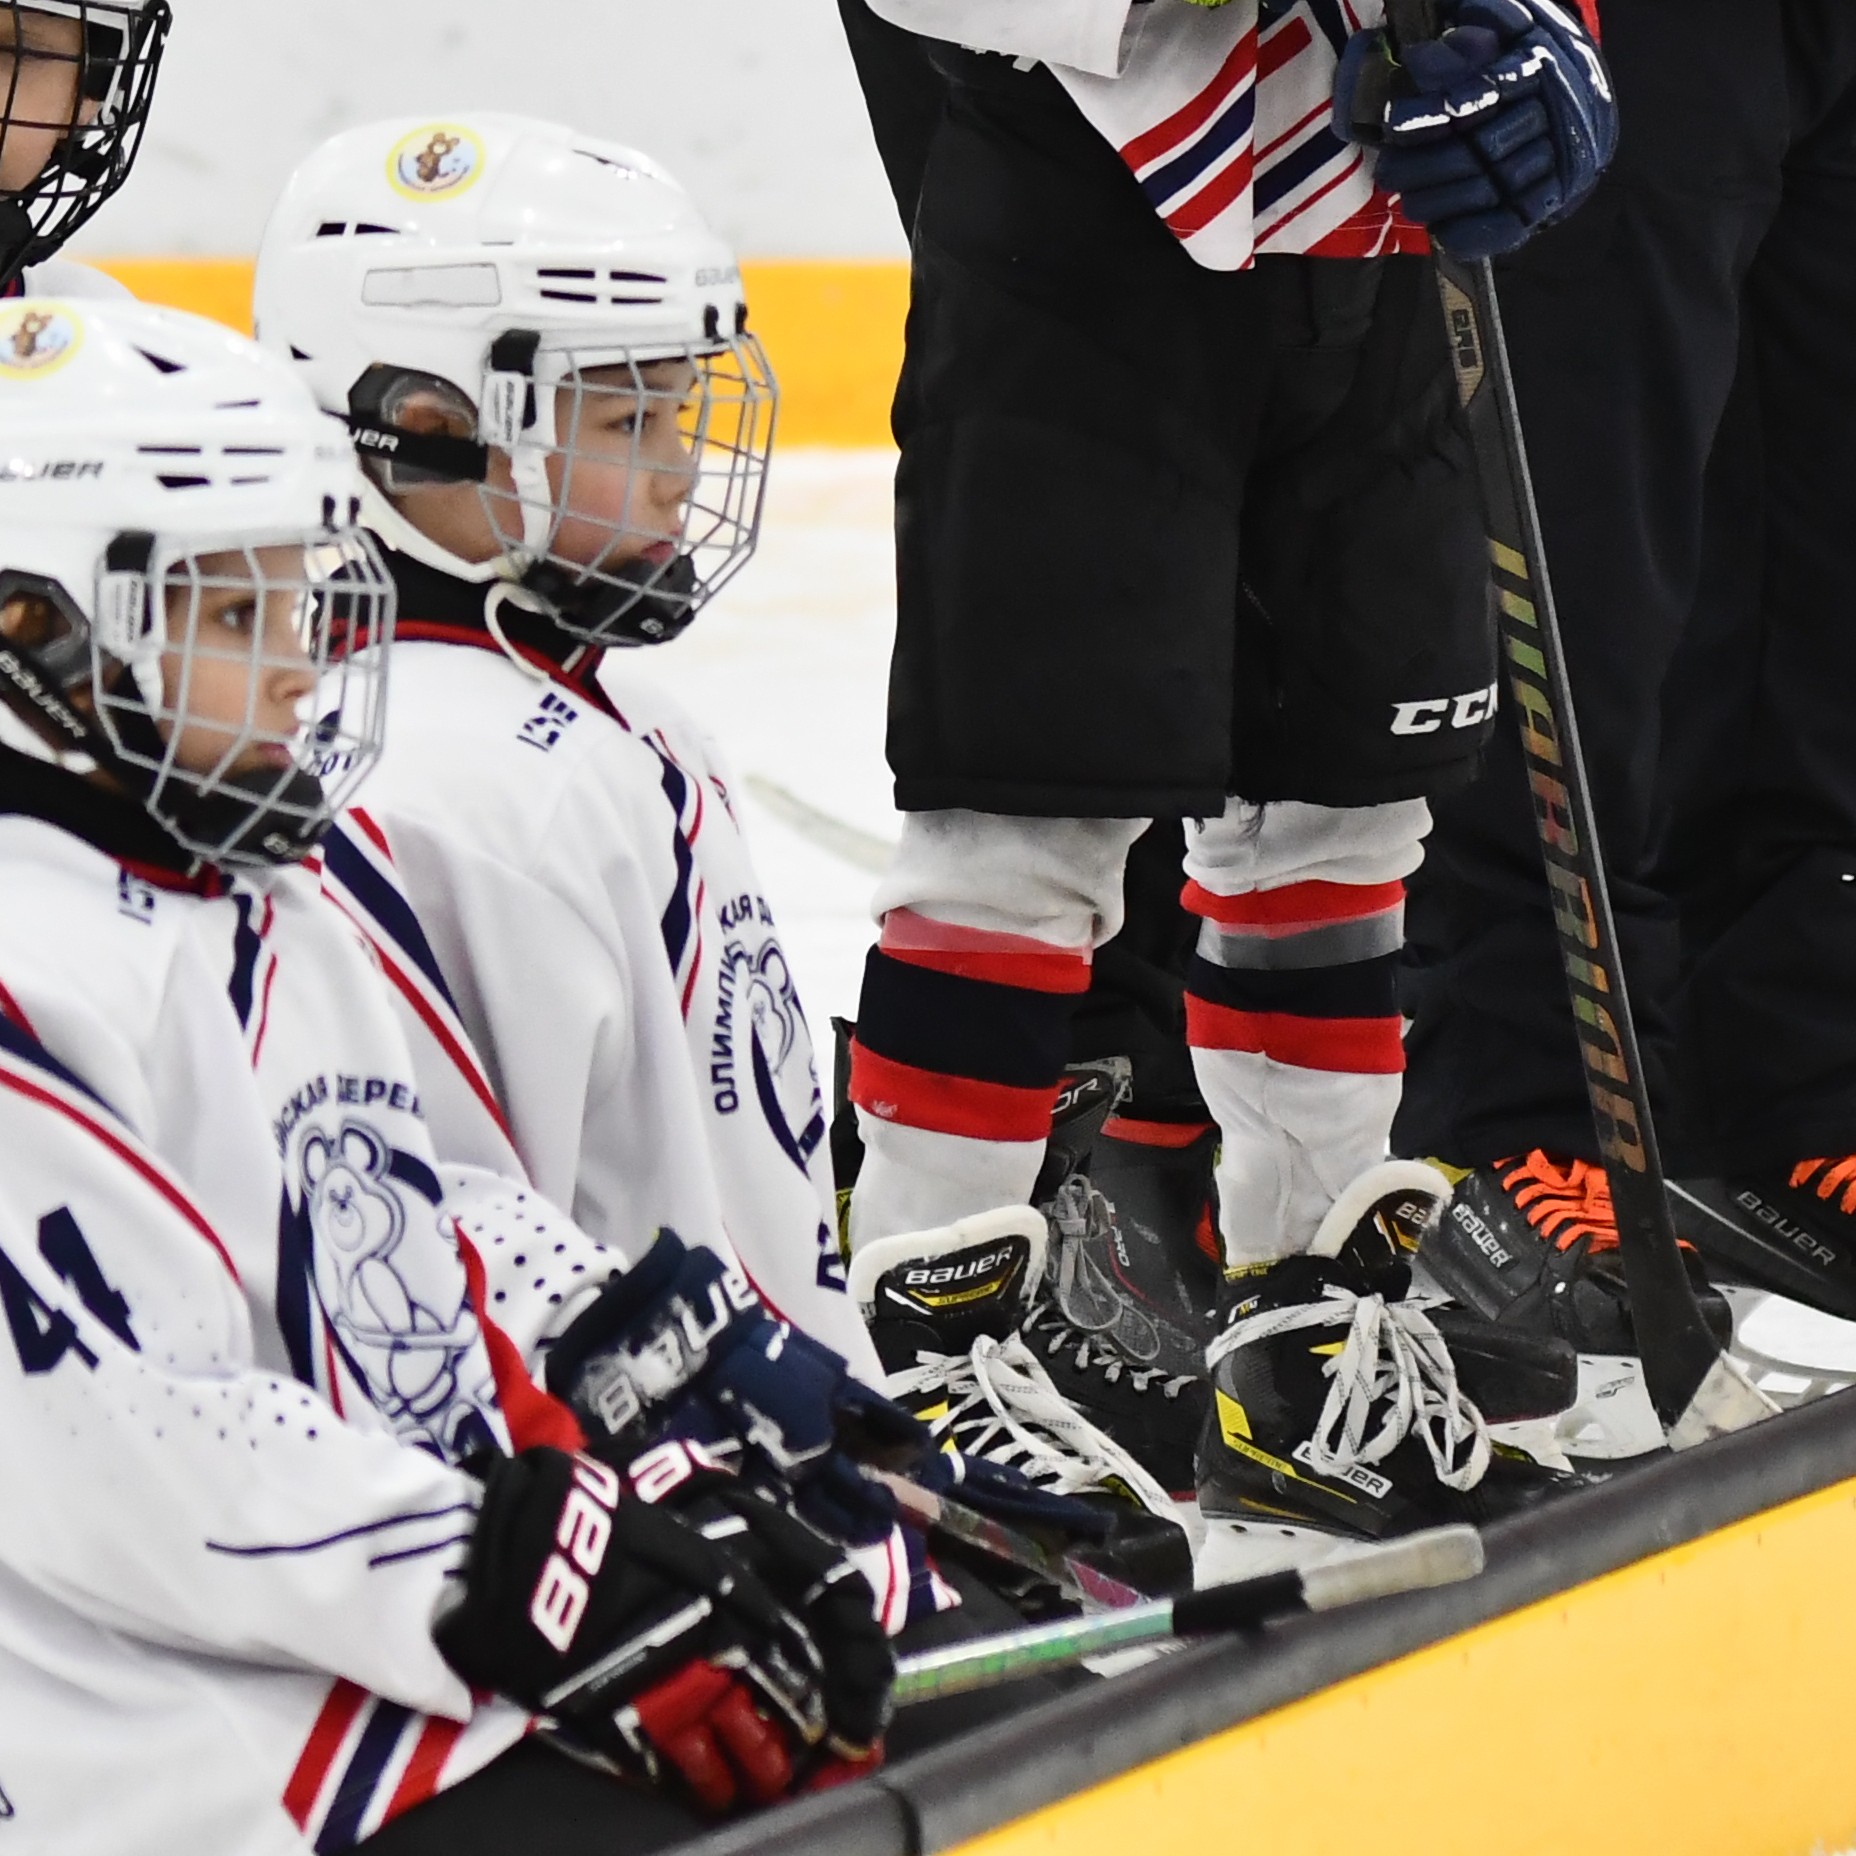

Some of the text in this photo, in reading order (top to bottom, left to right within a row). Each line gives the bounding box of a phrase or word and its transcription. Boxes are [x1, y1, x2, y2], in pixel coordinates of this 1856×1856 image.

[904, 1244, 1014, 1286] BAUER
[1452, 1203, 1510, 1269] BAUER
[529, 1448, 622, 1653] BAU
